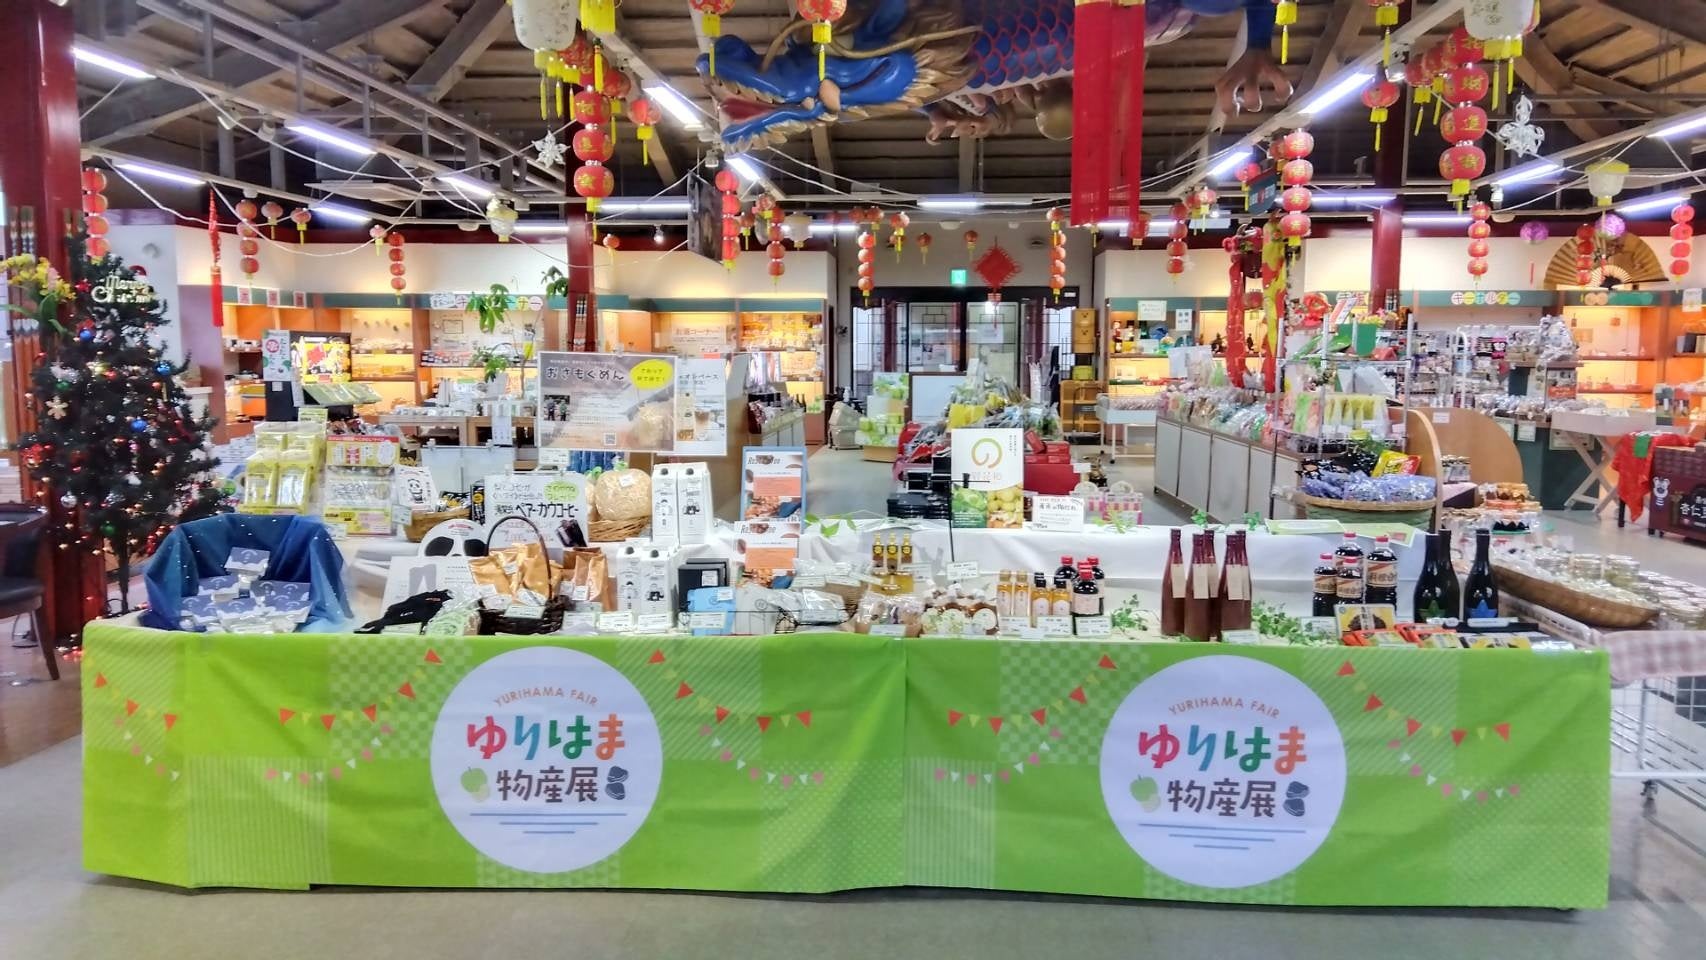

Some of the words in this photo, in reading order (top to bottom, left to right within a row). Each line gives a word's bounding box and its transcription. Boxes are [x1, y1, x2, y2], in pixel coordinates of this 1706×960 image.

[547, 366, 625, 382] おさもくめん
[495, 686, 565, 708] YURIHAMA
[570, 689, 598, 707] FAIR
[1168, 697, 1244, 716] YURIHAMA
[1250, 700, 1280, 719] FAIR
[466, 712, 626, 761] ゆりはま
[1138, 723, 1307, 775] ゆりはま
[495, 765, 599, 803] 物産展
[1167, 777, 1277, 818] 物産展
